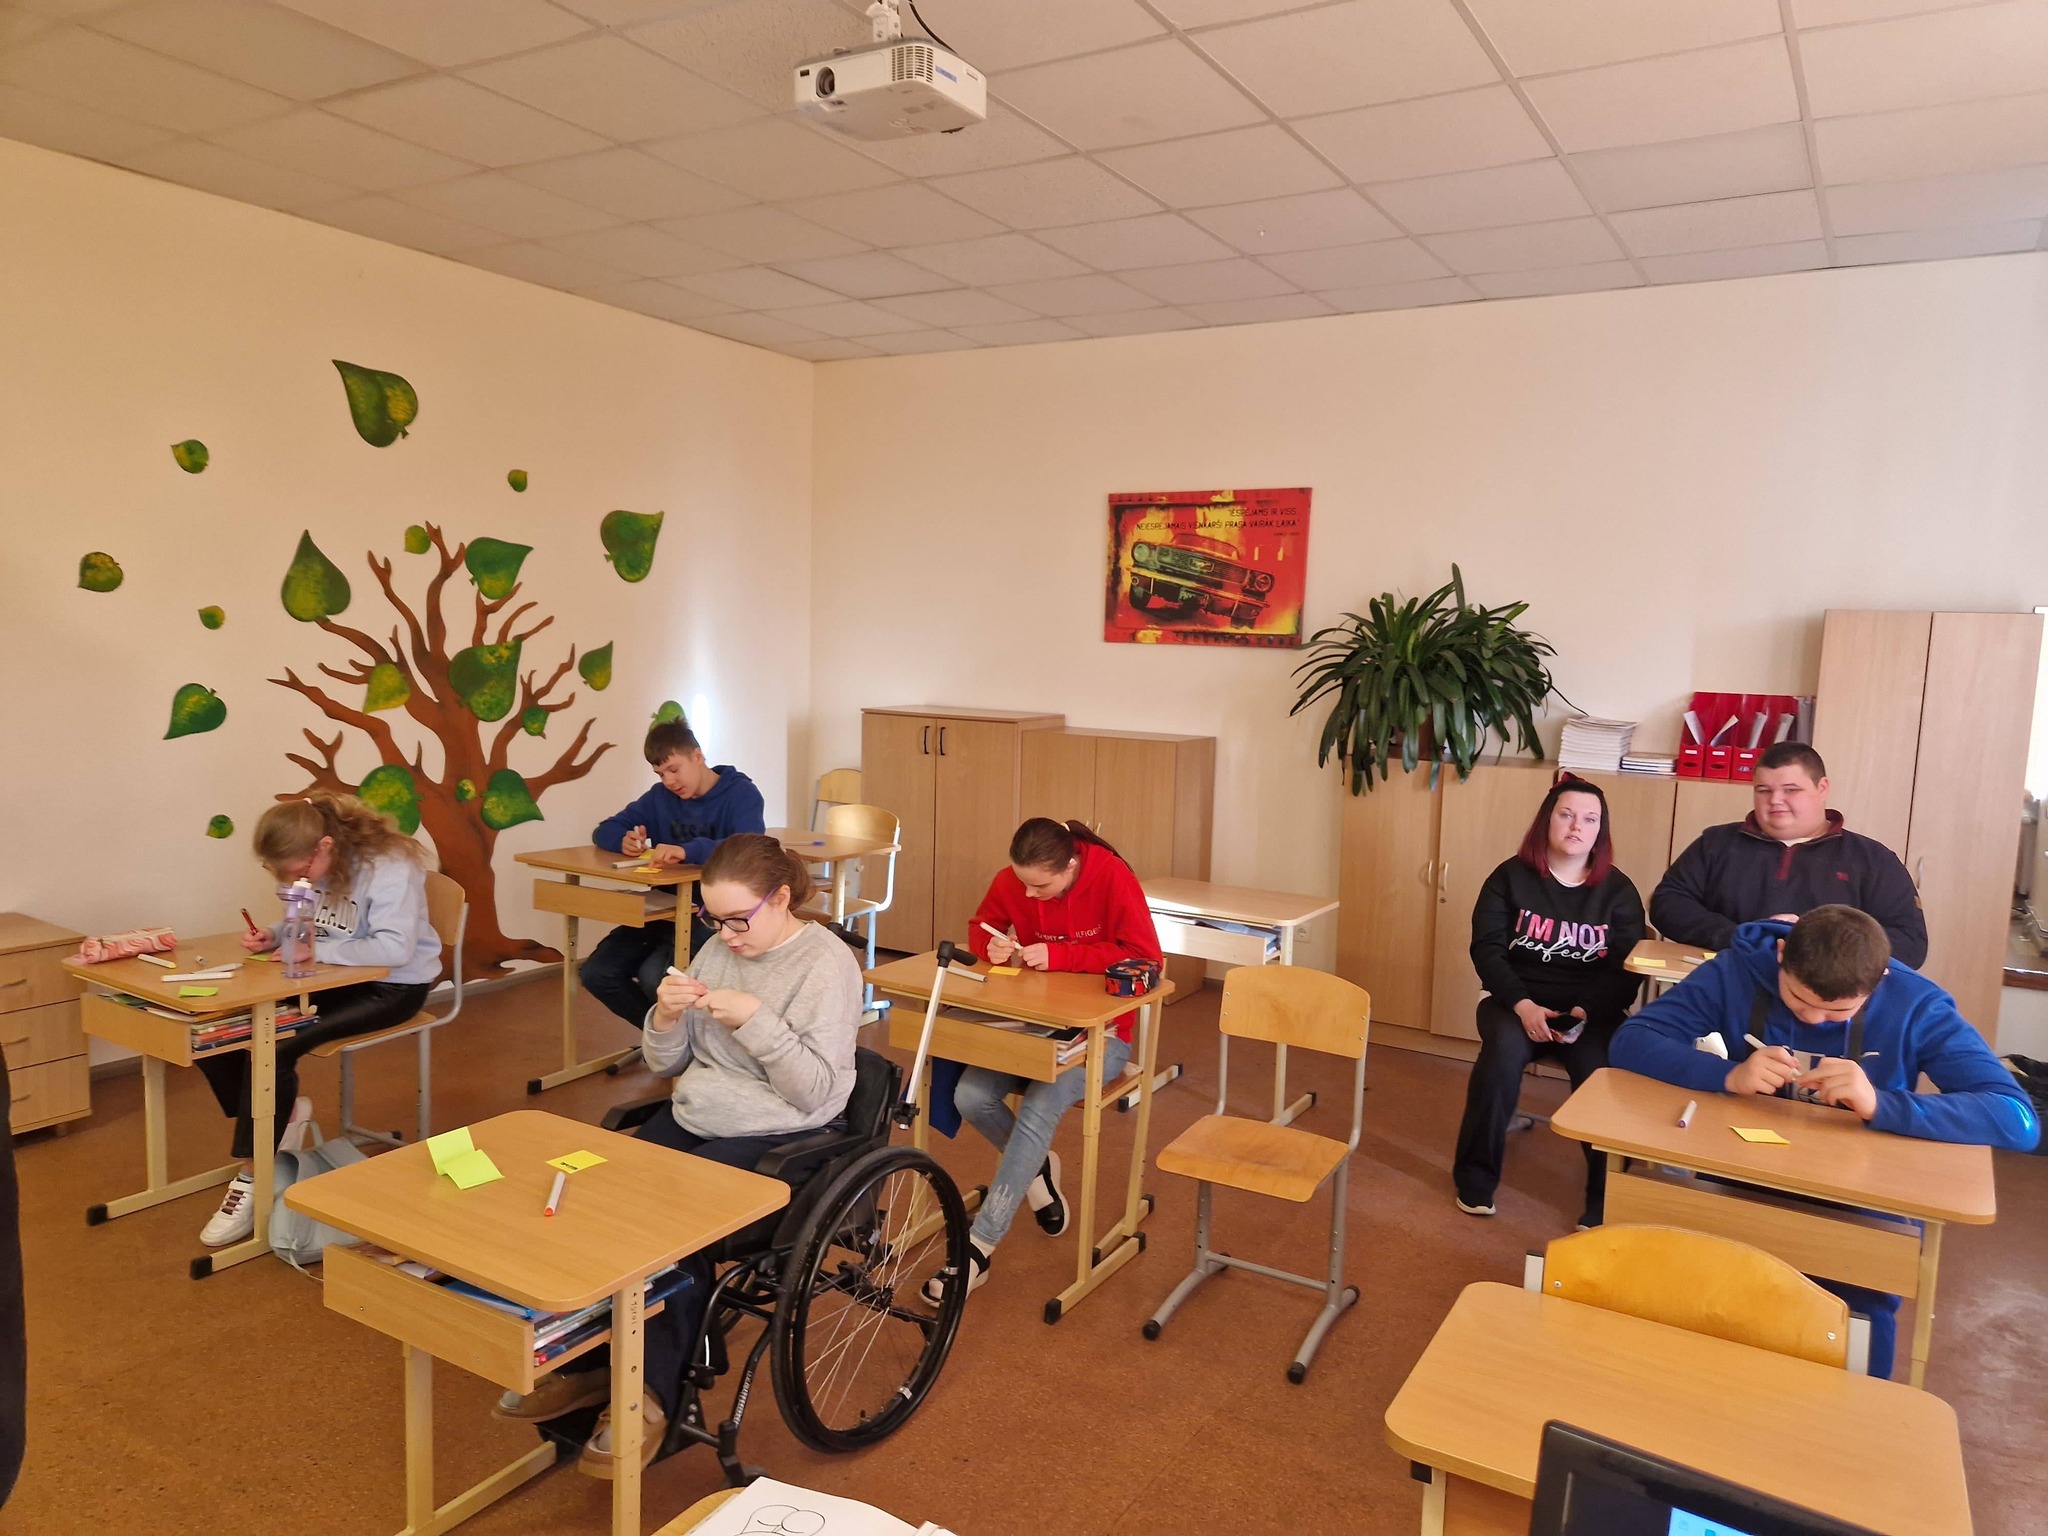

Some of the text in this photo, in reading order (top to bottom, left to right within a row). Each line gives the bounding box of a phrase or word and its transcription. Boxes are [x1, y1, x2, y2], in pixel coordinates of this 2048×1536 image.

[1515, 909, 1609, 950] I'M NOT
[1509, 935, 1608, 962] perfect
